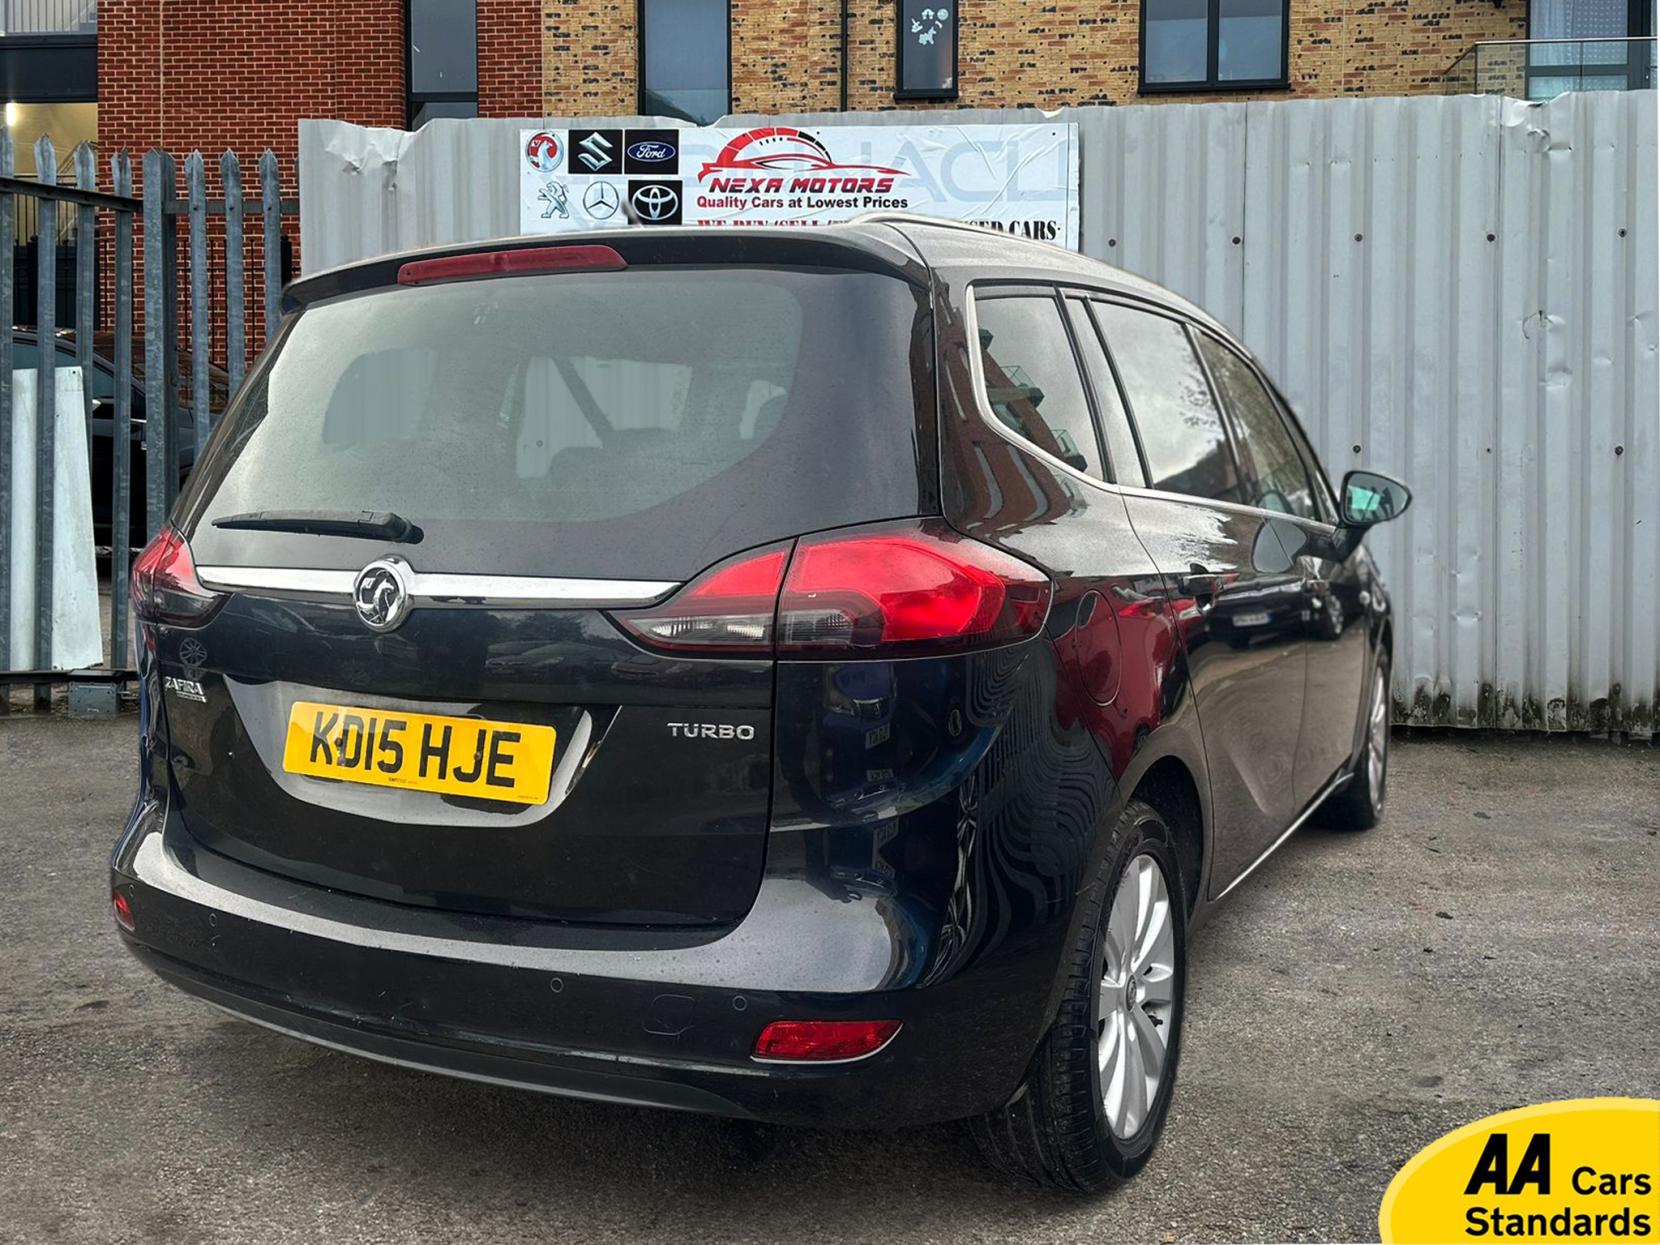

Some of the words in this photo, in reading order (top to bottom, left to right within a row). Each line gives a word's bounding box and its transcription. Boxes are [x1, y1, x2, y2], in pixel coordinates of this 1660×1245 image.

[635, 144, 666, 159] Ford
[709, 177, 784, 193] NEXA
[789, 177, 895, 193] MOTORS
[697, 196, 747, 210] Quality
[752, 196, 784, 208] Cars
[788, 196, 803, 208] at
[807, 196, 859, 208] Lowest
[862, 196, 909, 208] Prices
[667, 722, 755, 740] TURBO
[309, 711, 407, 774] KD15
[418, 723, 522, 788] HJE
